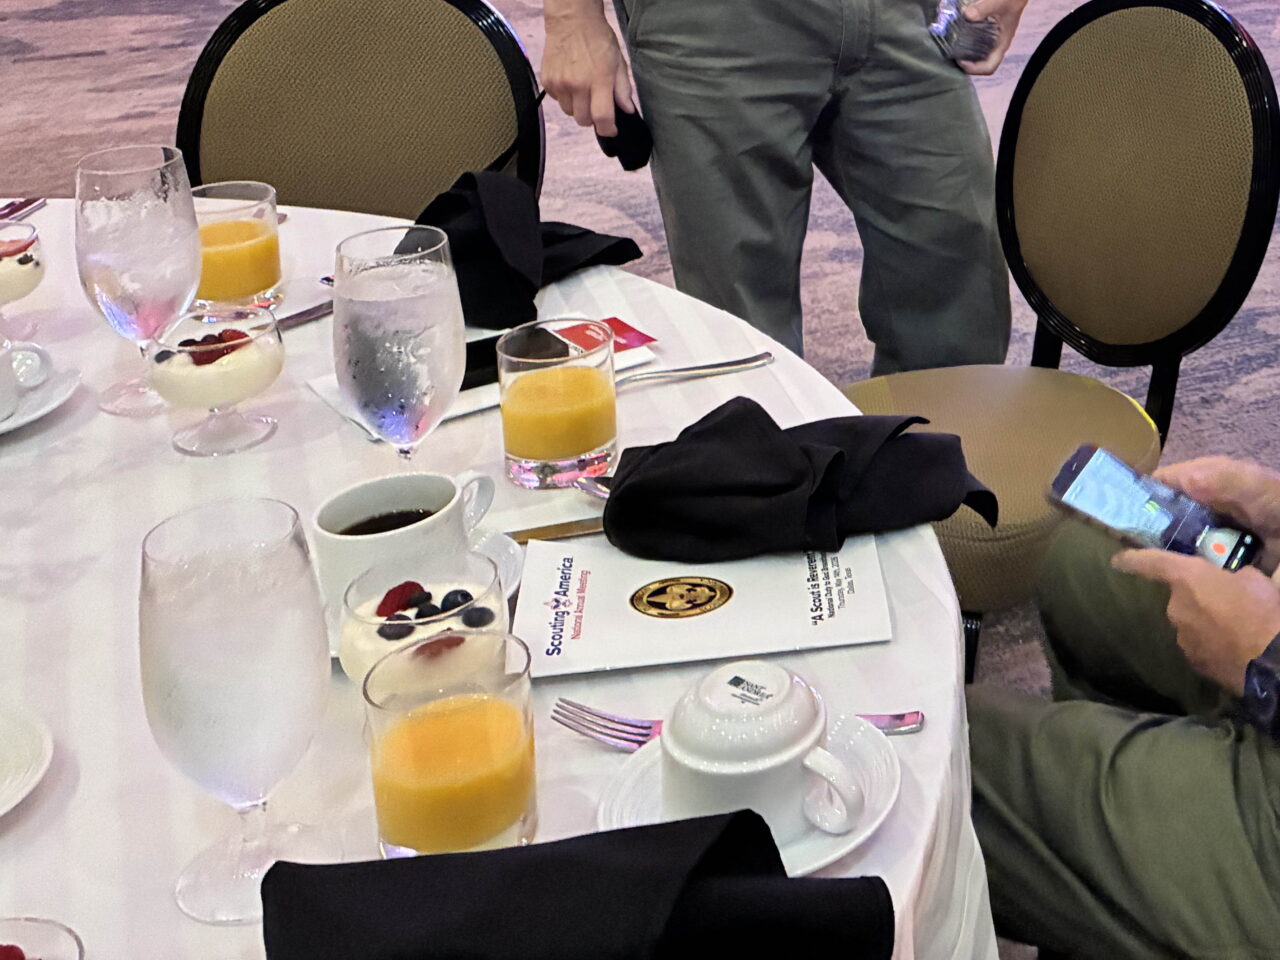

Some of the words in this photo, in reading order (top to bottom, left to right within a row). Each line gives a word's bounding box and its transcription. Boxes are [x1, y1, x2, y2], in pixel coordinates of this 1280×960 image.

[554, 557, 574, 597] America
[810, 591, 823, 613] Scout
[545, 610, 571, 656] Scouting
